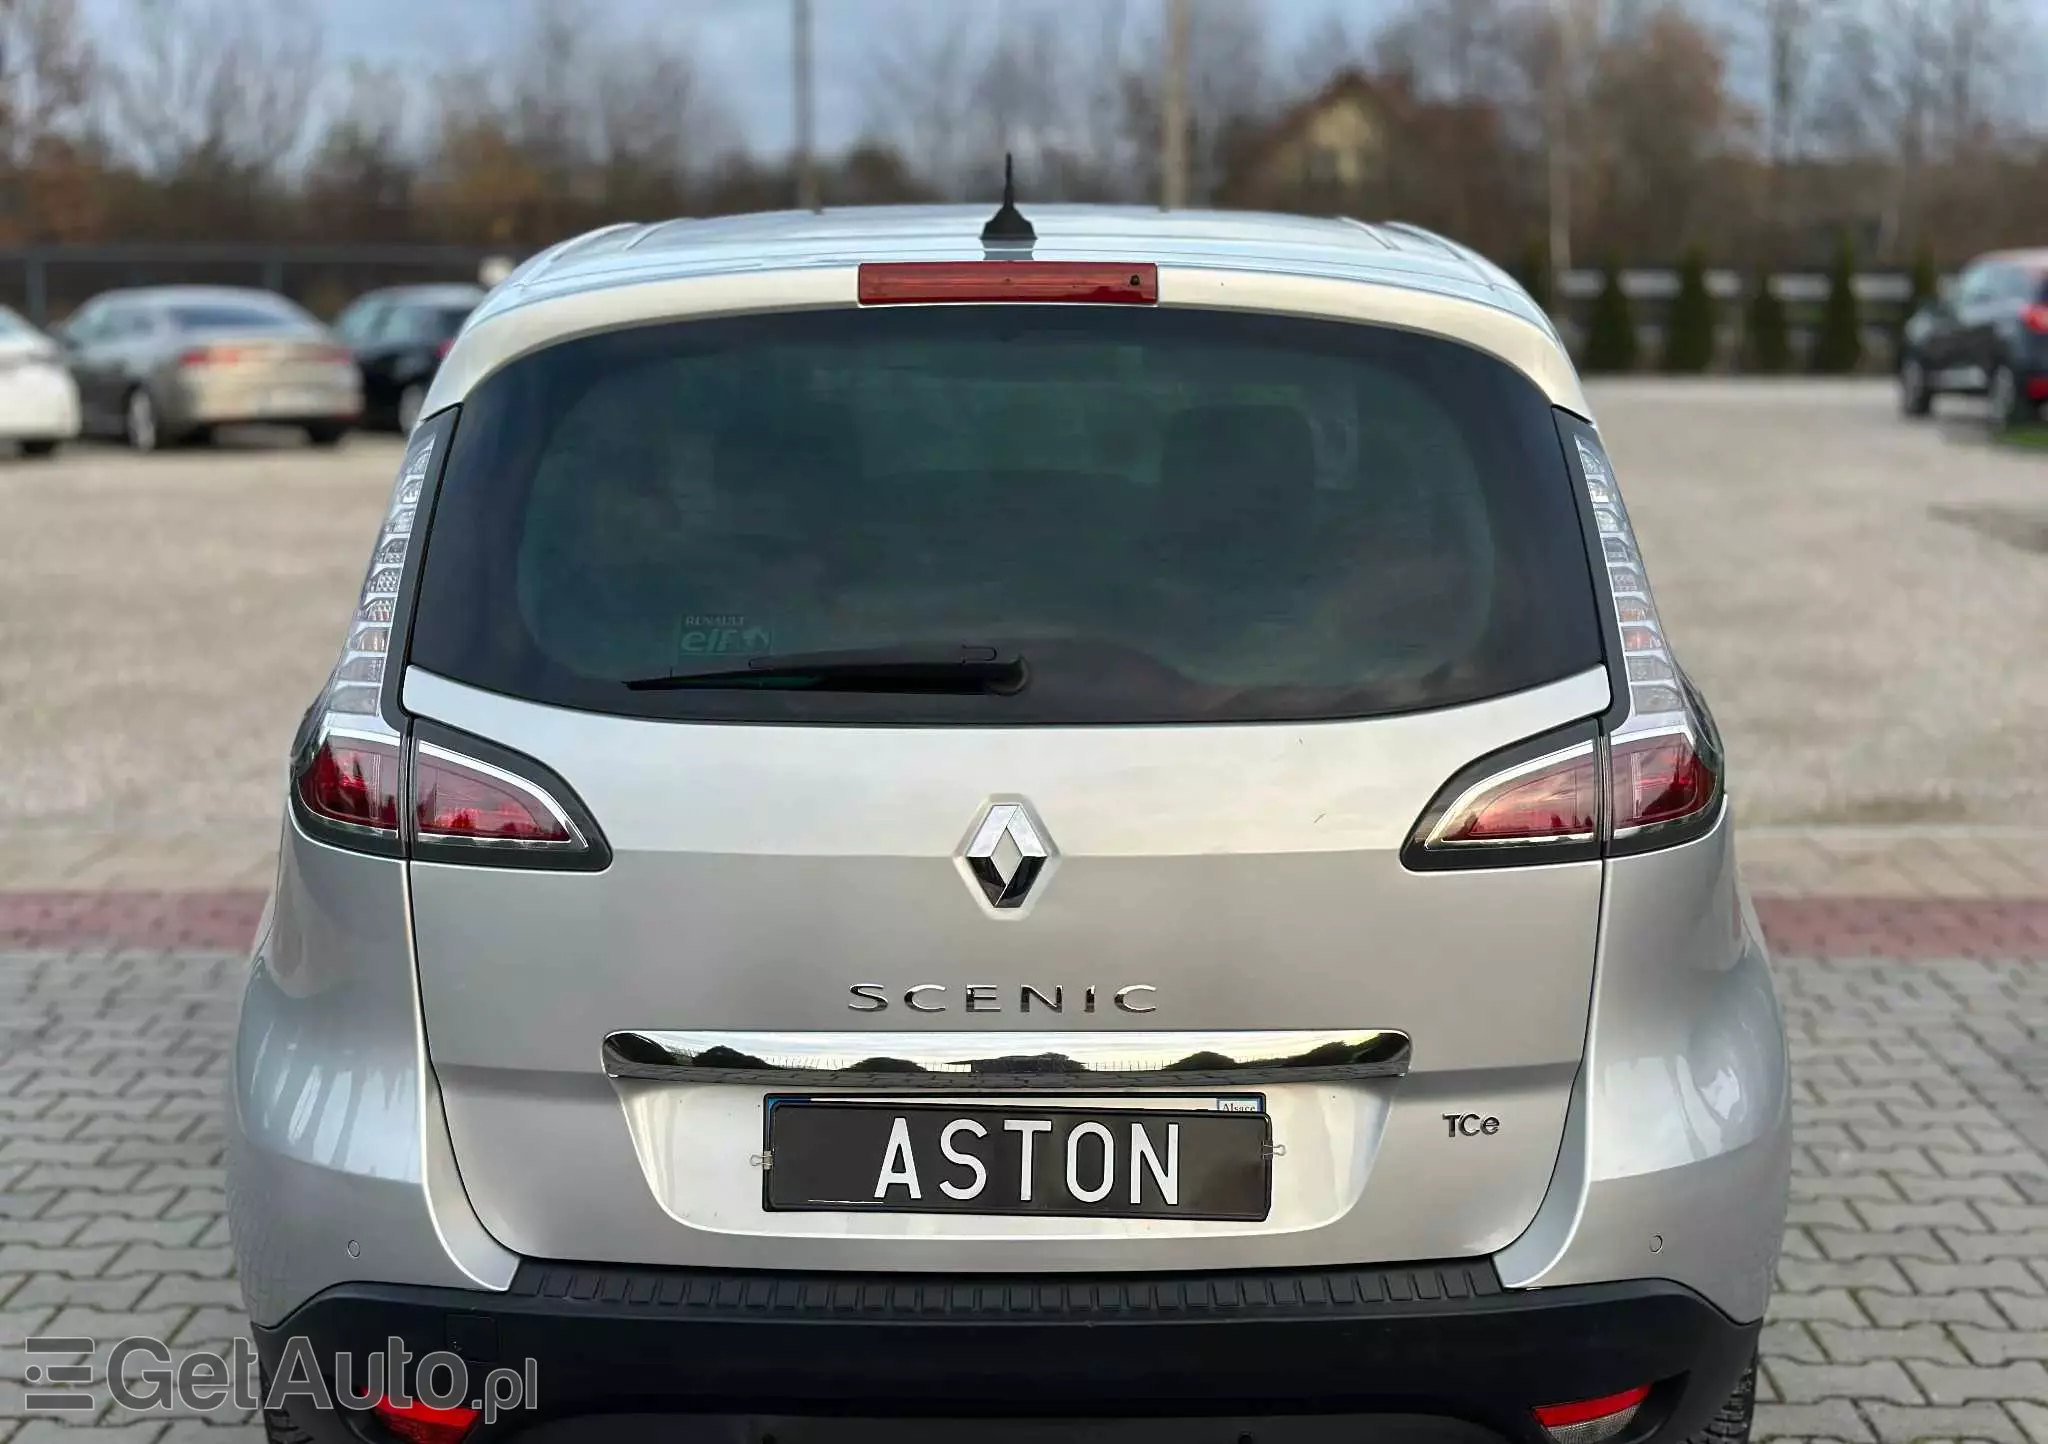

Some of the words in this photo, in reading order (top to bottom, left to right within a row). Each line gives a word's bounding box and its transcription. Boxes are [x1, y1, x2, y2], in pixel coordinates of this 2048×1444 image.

[848, 983, 1157, 1013] SCENIC
[1442, 1113, 1500, 1137] TCe
[873, 1117, 1179, 1205] ASTON
